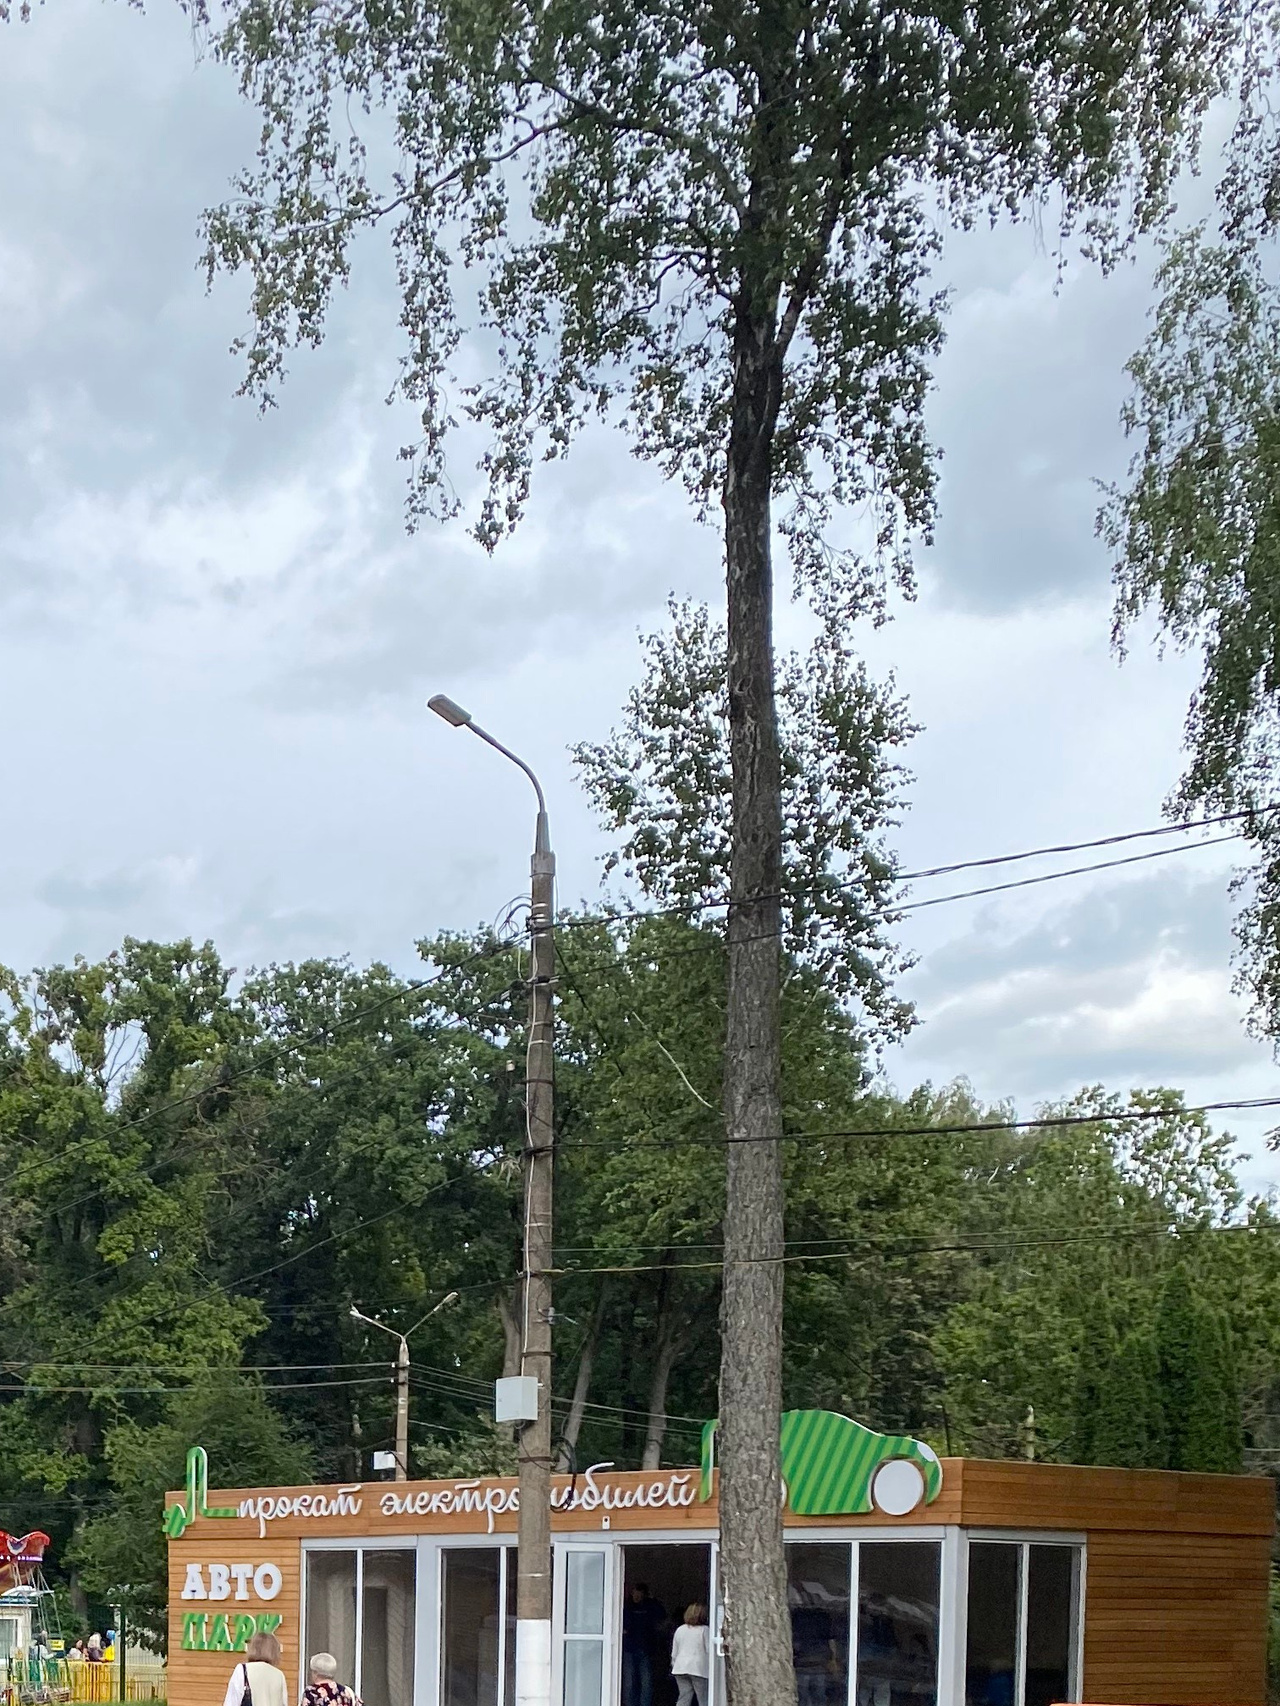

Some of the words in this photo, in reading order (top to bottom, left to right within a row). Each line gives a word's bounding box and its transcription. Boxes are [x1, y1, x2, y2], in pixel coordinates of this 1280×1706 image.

[238, 1485, 363, 1539] прокат
[380, 1462, 696, 1534] электрообилей
[181, 1563, 283, 1601] АВТО
